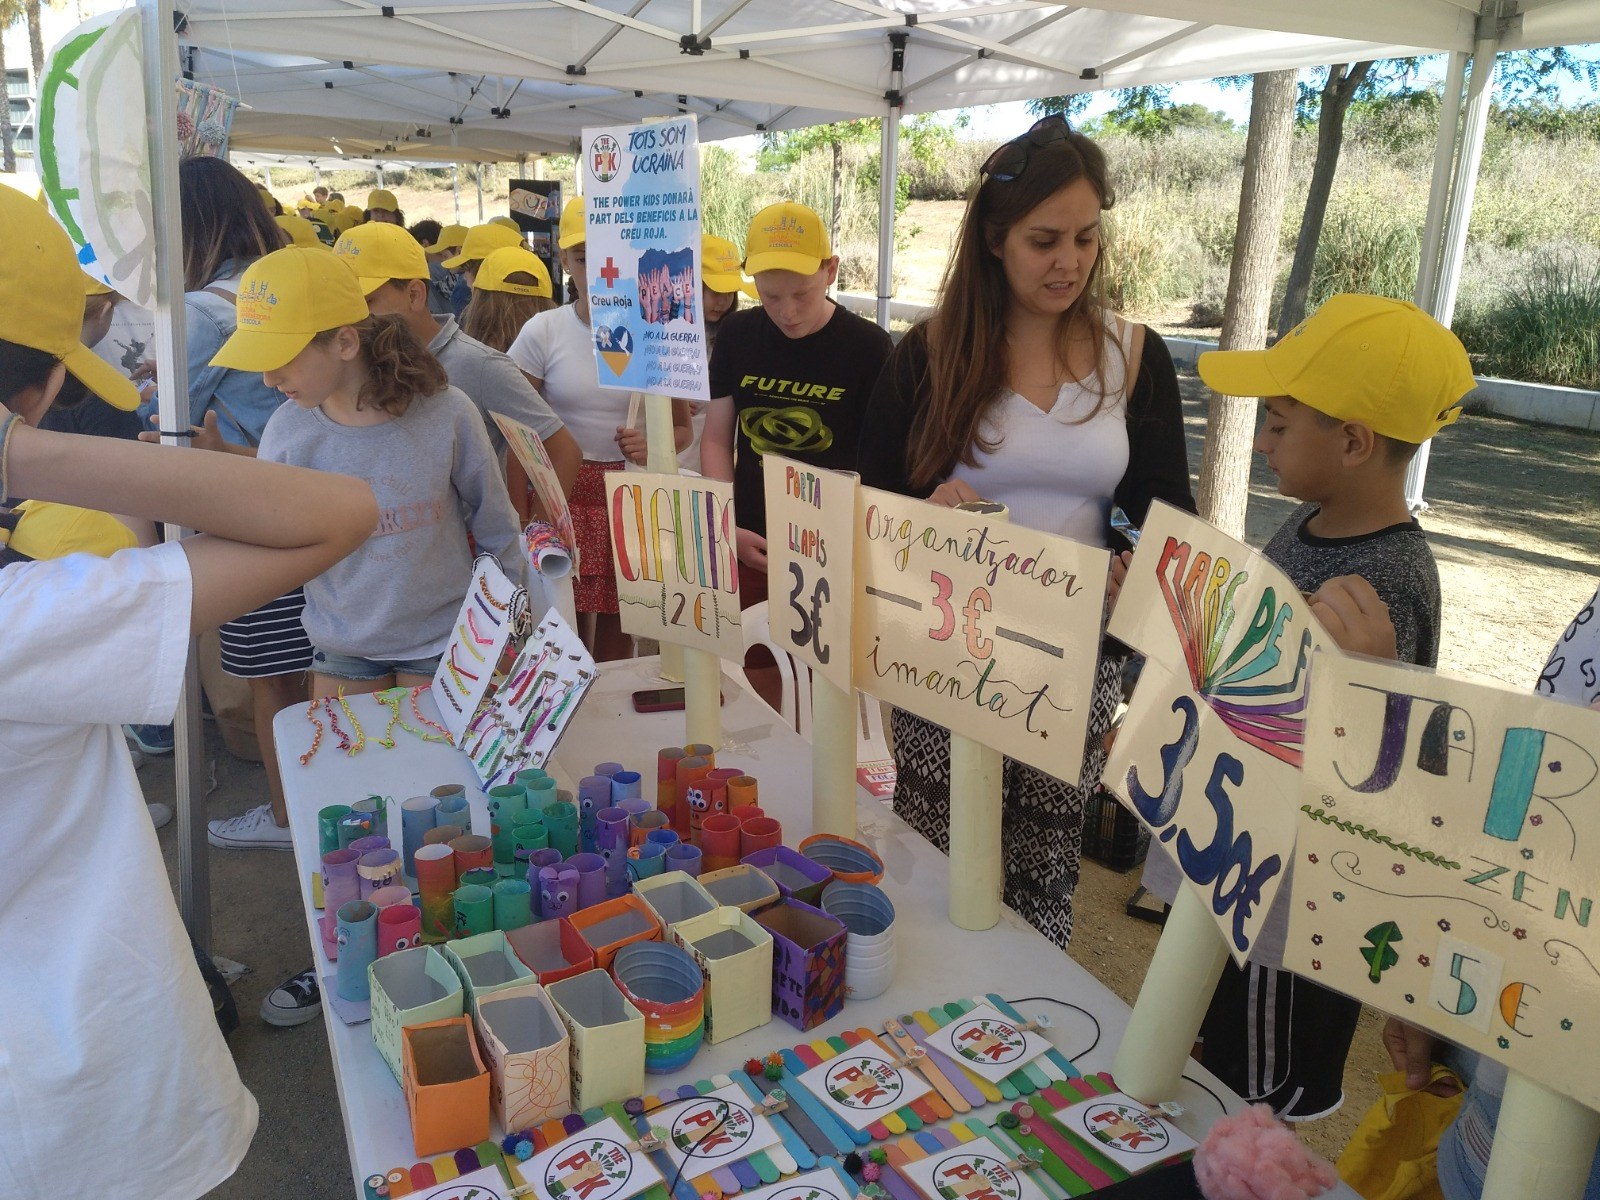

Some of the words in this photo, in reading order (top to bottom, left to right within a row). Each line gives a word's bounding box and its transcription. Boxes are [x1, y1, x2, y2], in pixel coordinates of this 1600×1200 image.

[628, 129, 656, 152] TOTS
[659, 124, 687, 147] SOM
[632, 148, 685, 175] UCRAÏNA
[593, 197, 609, 209] THE
[612, 195, 640, 208] POWER
[643, 193, 660, 206] KIDS
[662, 187, 694, 206] DONARÀ
[589, 213, 612, 225] PART
[614, 211, 635, 224] DELS
[636, 209, 677, 223] BENEFICIS
[679, 209, 685, 221] A
[687, 208, 698, 221] LA
[620, 228, 642, 240] CREU
[643, 227, 668, 239] ROJA.
[641, 283, 691, 300] PEACE
[591, 295, 612, 307] Creu
[613, 295, 633, 309] Roja
[661, 331, 670, 341] LA
[670, 332, 700, 343] GUERRA!
[740, 374, 846, 401] FUTURE
[786, 465, 822, 509] PORTA
[789, 561, 831, 665] 3€
[1333, 682, 1599, 861] JAR
[1463, 855, 1593, 928] ZEN
[997, 1023, 1017, 1038] THE
[876, 1063, 896, 1079] THE
[731, 1109, 749, 1126] THE
[1136, 1113, 1158, 1128] THE
[607, 1146, 627, 1165] THE
[990, 1164, 1014, 1183] THE
